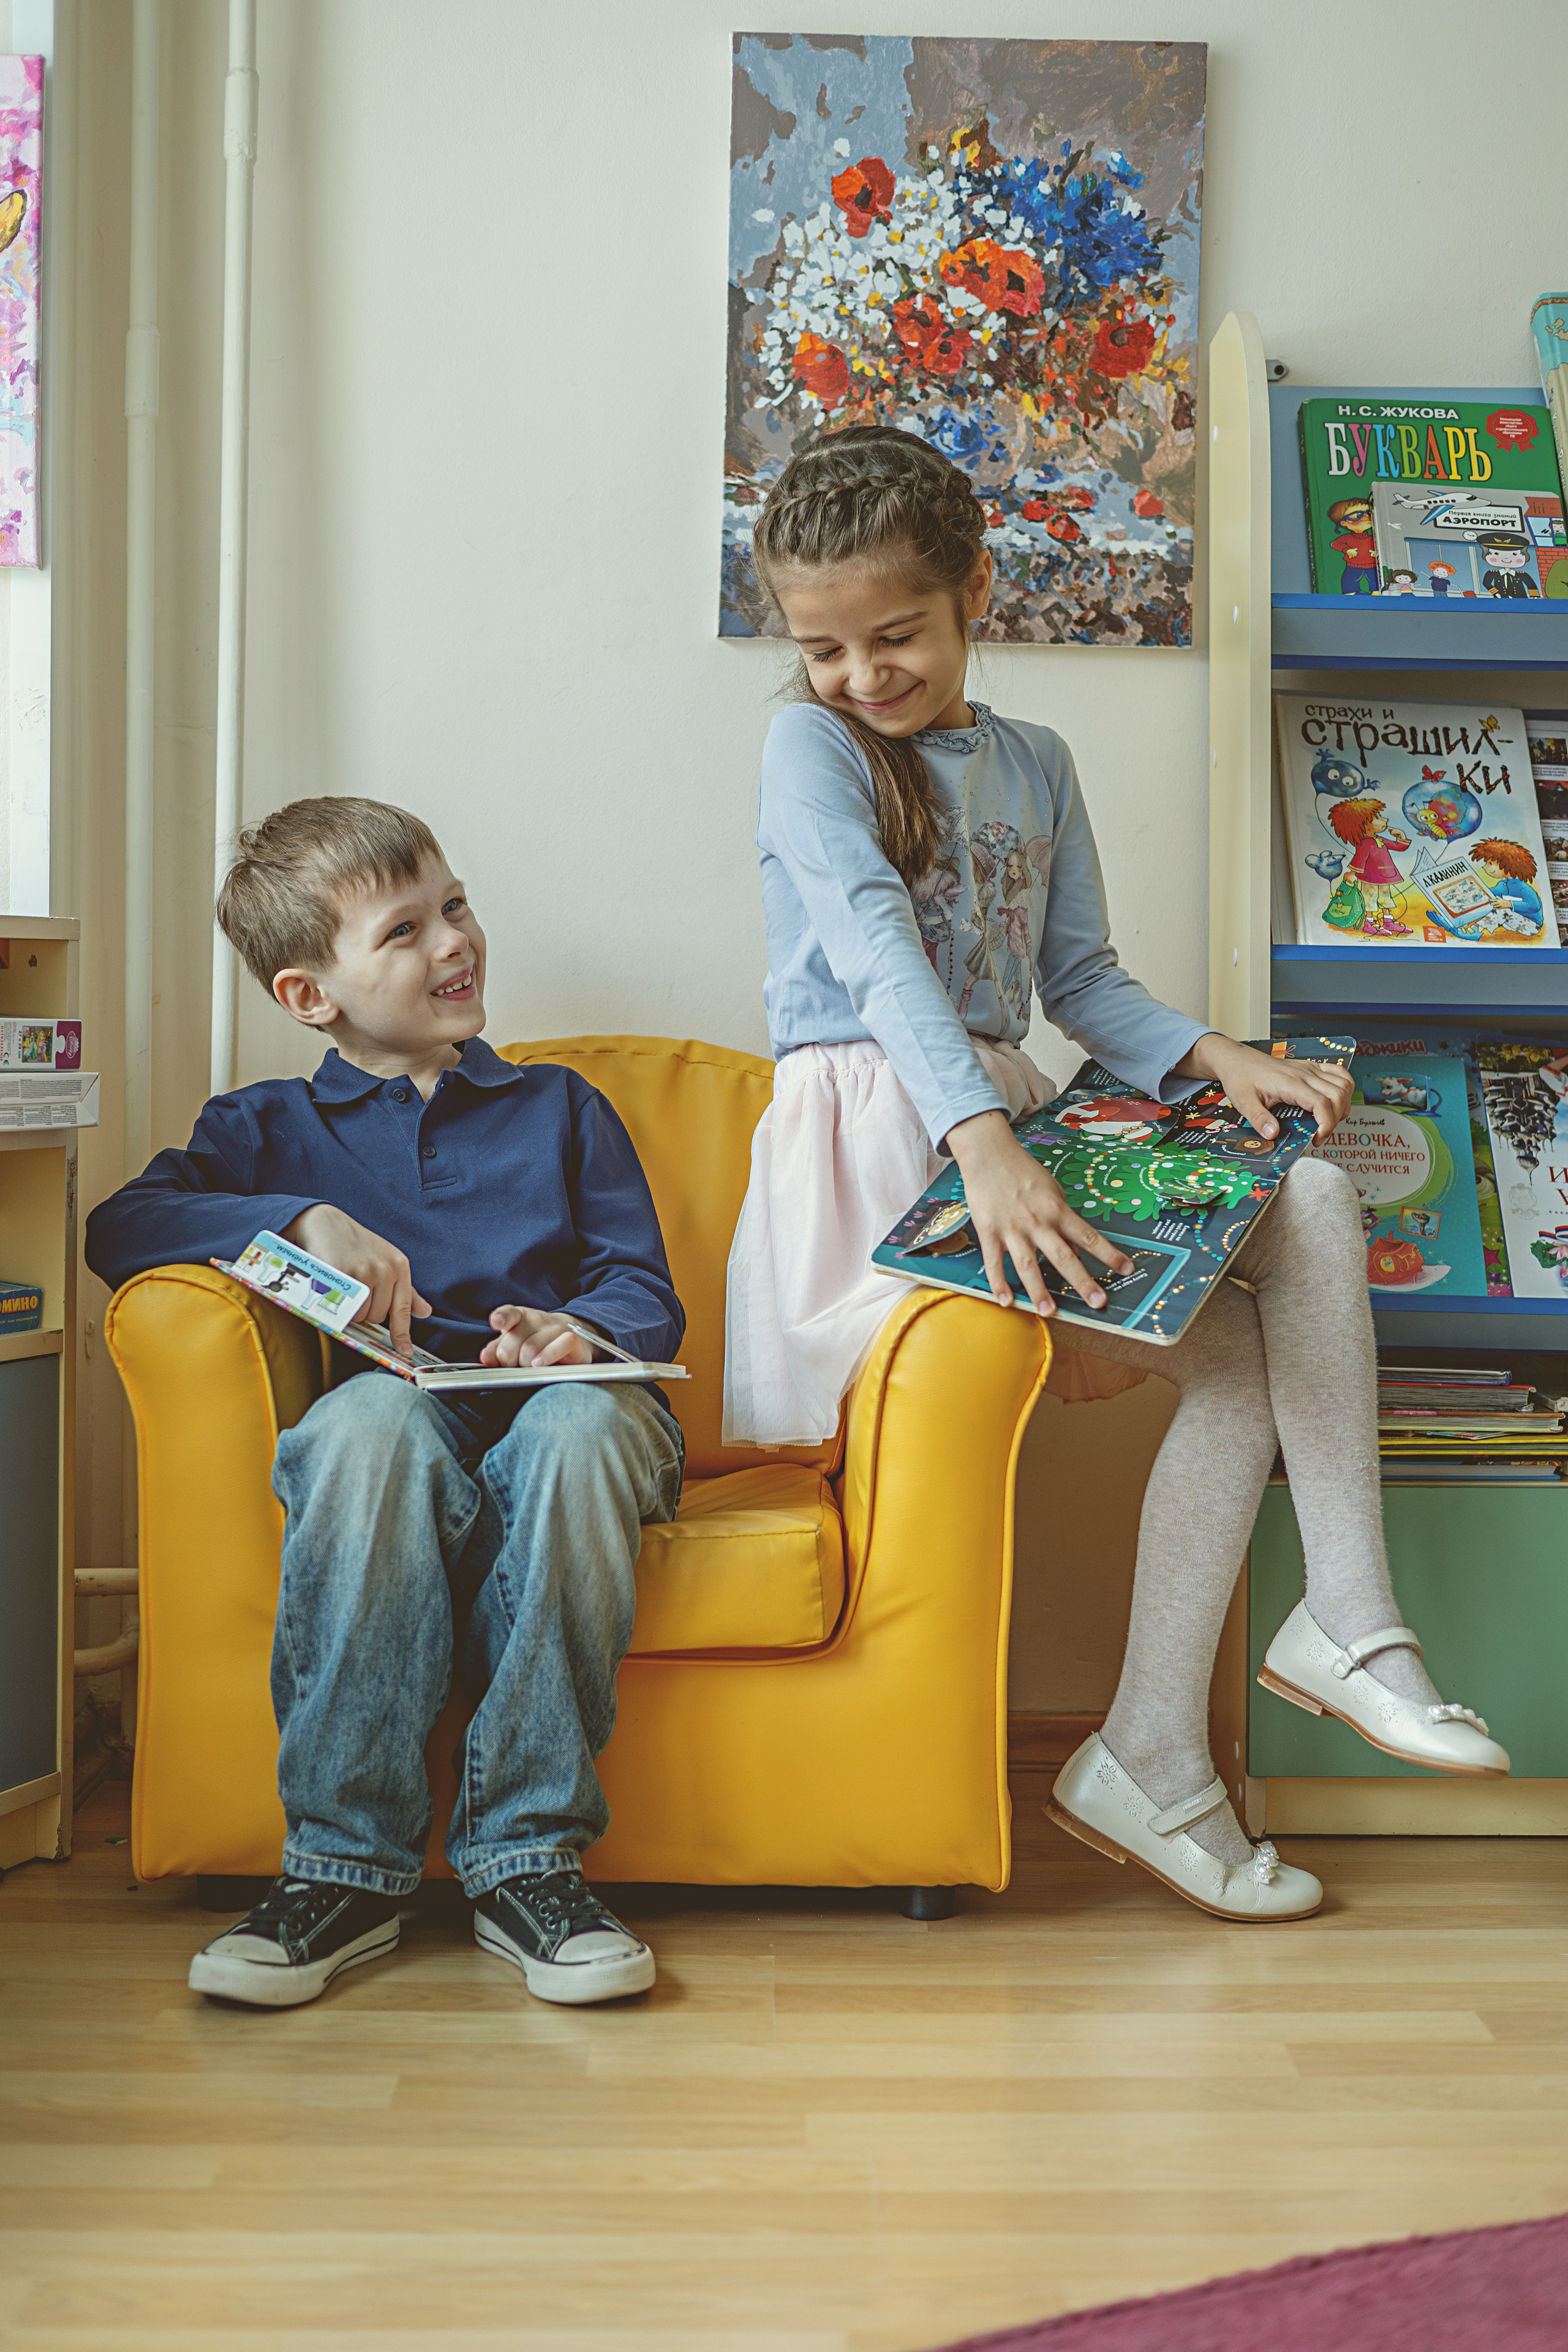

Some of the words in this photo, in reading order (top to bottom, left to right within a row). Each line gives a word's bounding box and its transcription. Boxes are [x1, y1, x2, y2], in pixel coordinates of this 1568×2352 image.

[1379, 405, 1459, 420] ЖУКОВА
[1324, 422, 1492, 482] БУКВАРЬ
[1442, 516, 1517, 527] АЭРОПОРТ
[1382, 709, 1394, 720] и
[1345, 1118, 1357, 1127] Кир
[1324, 1133, 1411, 1149] ДЕВОЧКА,
[1322, 1148, 1376, 1160] КОТОРОЙ
[1380, 1151, 1425, 1162] НИЧЕГО
[1346, 1163, 1410, 1175] СЛУЧИТСЯ
[311, 1263, 351, 1291] Становись
[0, 1295, 38, 1314] МИНО
